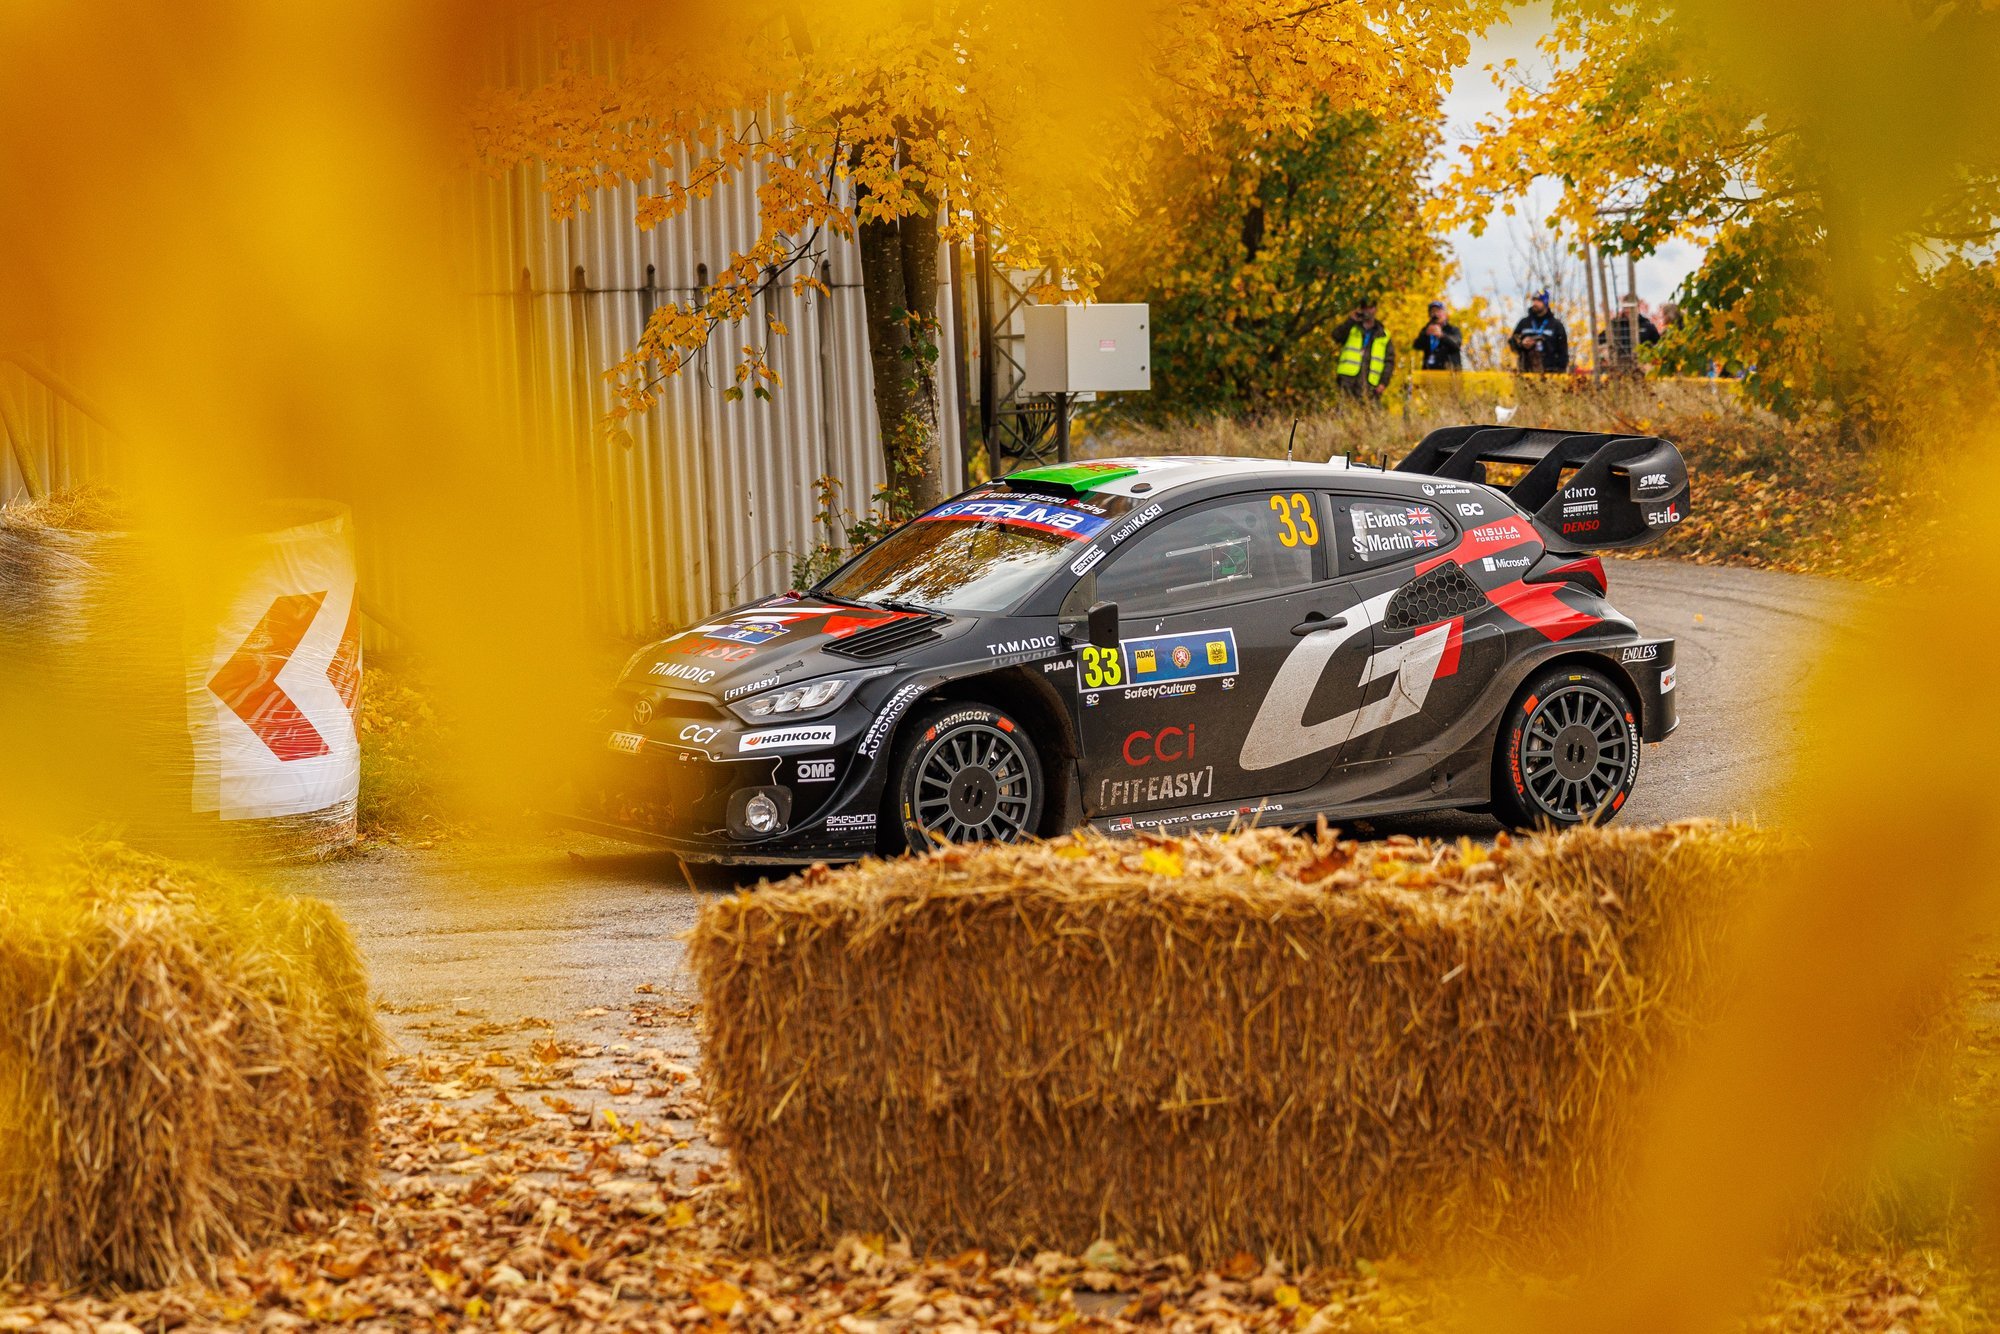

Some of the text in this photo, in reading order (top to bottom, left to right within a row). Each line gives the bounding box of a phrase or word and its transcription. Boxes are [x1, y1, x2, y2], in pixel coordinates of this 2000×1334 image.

[1639, 473, 1671, 487] SWS
[1024, 493, 1067, 504] GAZOO
[1064, 499, 1107, 515] Racing
[1648, 502, 1680, 525] Stilo
[956, 503, 1085, 529] FORUM8
[1110, 503, 1163, 545] AsahiKASEI
[1269, 493, 1319, 547] 33
[1351, 512, 1407, 529] E.Evans
[1473, 525, 1519, 538] NISULA
[1562, 519, 1600, 534] DENSO
[1352, 533, 1413, 553] S.Martin
[1072, 548, 1103, 574] CENTRAL
[1495, 556, 1531, 568] Microsoft
[987, 635, 1056, 656] TAMADIC
[1136, 650, 1154, 659] ADAC
[1621, 645, 1658, 661] ENDLESS
[648, 662, 716, 684] TAMADIC
[1044, 659, 1074, 673] PIAA
[1082, 646, 1122, 688] 33
[1124, 682, 1197, 700] SafetyCulture
[1222, 678, 1235, 689] SC
[1086, 693, 1099, 704] SC
[857, 683, 916, 755] Panasonic
[868, 684, 928, 760] AUTOMOTIVE
[797, 762, 836, 778] OMP
[826, 813, 876, 824] akebono
[1136, 815, 1190, 829] TOYOTA
[1191, 809, 1238, 821] GAZOO
[1238, 803, 1284, 815] Racing
